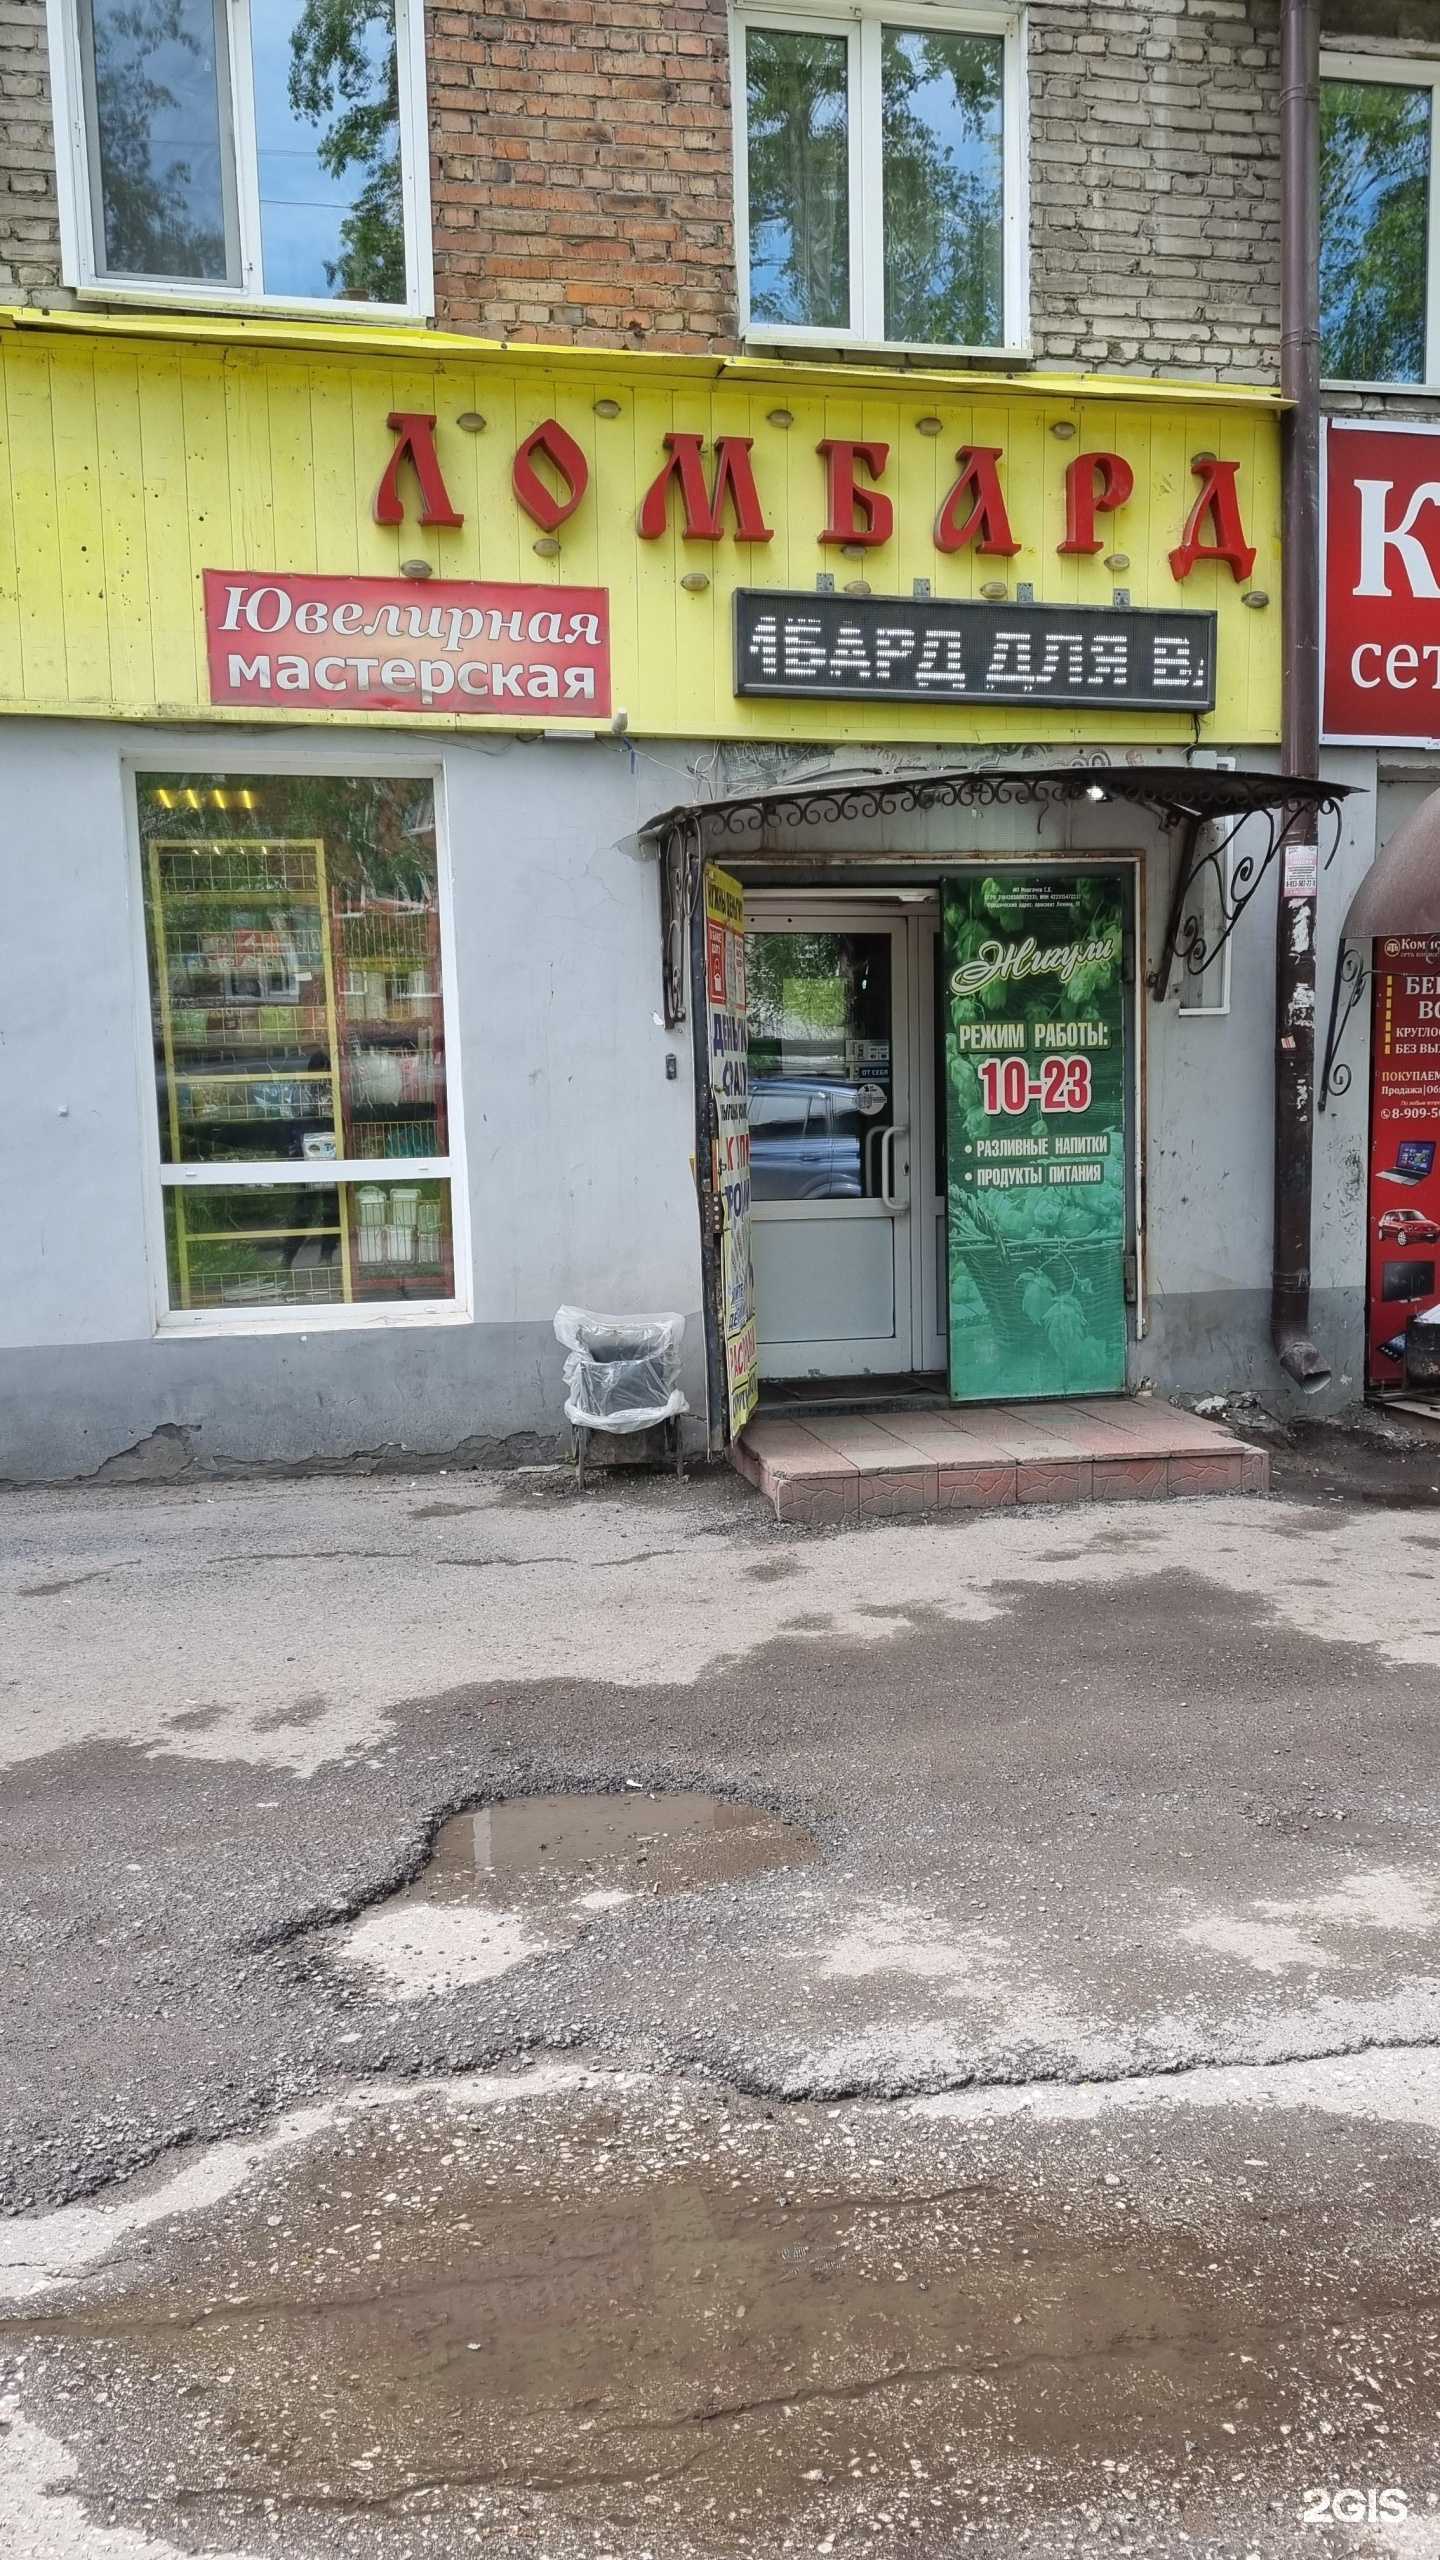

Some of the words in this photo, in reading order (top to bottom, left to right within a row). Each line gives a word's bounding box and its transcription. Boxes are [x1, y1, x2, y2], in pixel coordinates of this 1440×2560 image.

[373, 412, 1257, 583] ЛОМБАРД
[217, 586, 603, 651] Ювелирная
[227, 654, 595, 704] мастерская
[985, 631, 1128, 692] ДЛЯ
[1153, 637, 1204, 687] В
[951, 937, 1113, 995] Жигули
[959, 1024, 1025, 1049] РЕЖИМ
[1034, 1022, 1109, 1048] РАБОТЫ:
[1395, 1043, 1417, 1054] БЕЗ
[1396, 1027, 1440, 1038] КРУГЛО
[978, 1055, 1092, 1116] 10-23
[1391, 1107, 1440, 1119] 8-909-5
[977, 1138, 1049, 1157] РАЗЛИВНЫЕ
[1055, 1136, 1108, 1155] НАПИТКИ
[977, 1166, 1043, 1188] ПРОДУКТЫ
[1050, 1164, 1101, 1183] ПИТАНИЯ
